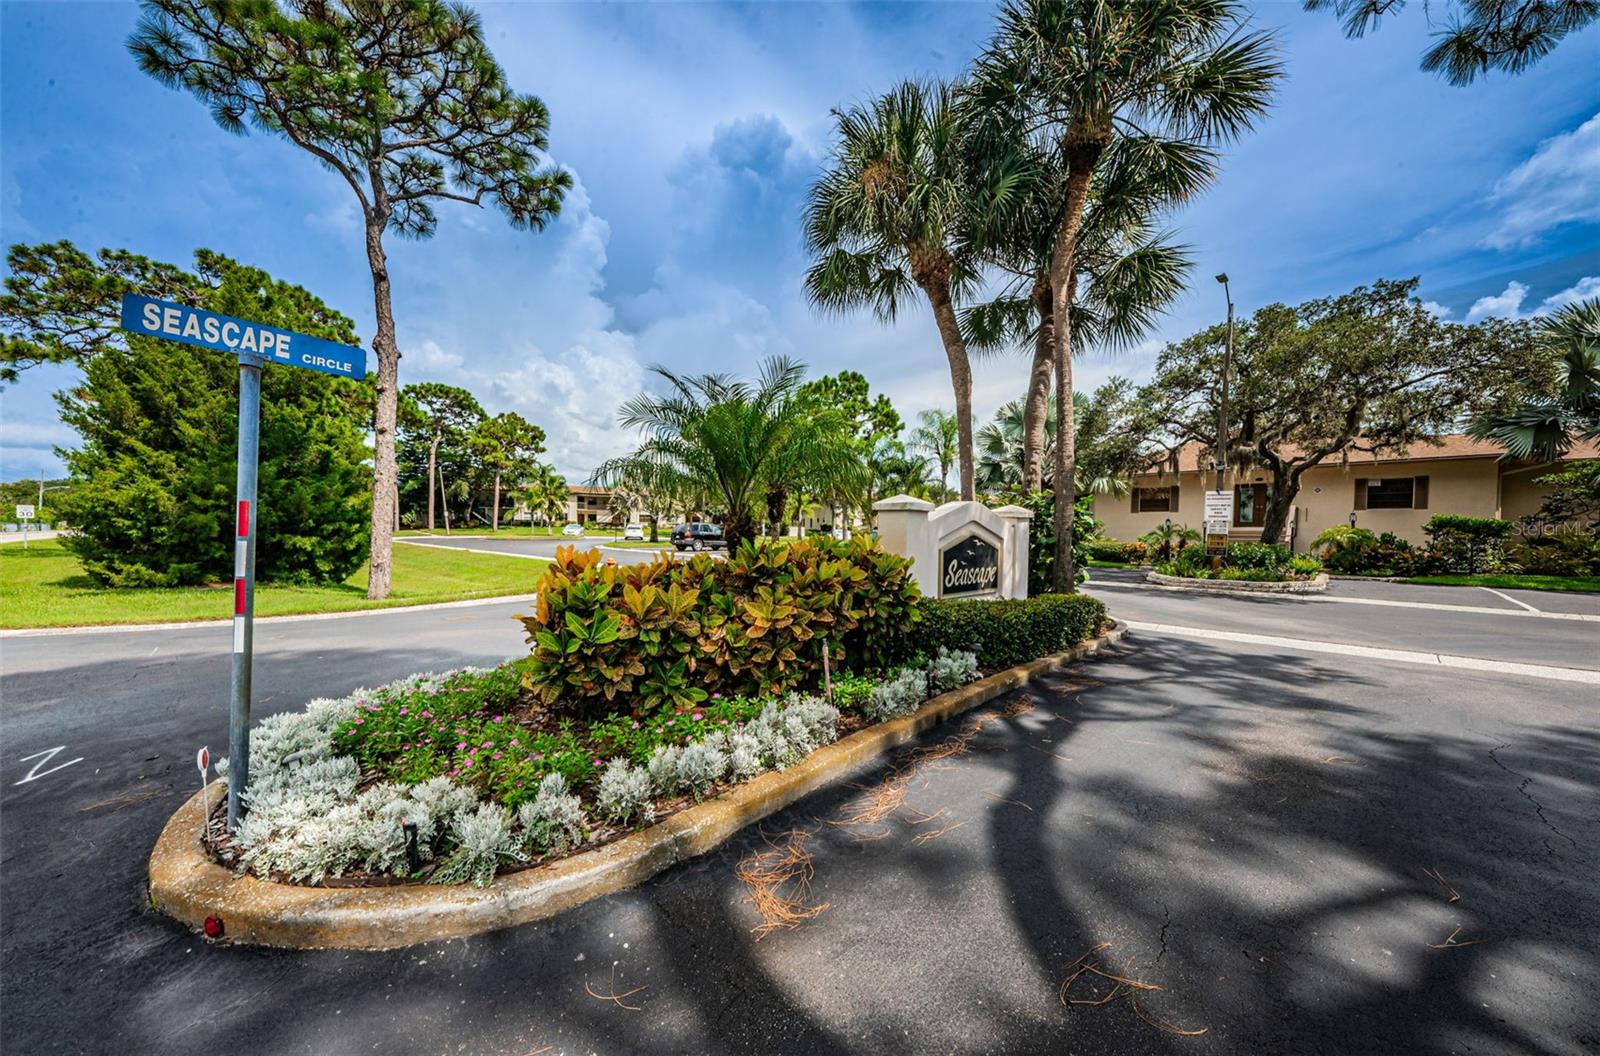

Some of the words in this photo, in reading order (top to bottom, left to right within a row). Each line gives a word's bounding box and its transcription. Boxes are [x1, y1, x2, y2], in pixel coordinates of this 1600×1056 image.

[142, 303, 291, 359] SEASCAPE
[301, 353, 353, 373] CIRCLE
[945, 559, 997, 588] Seascape
